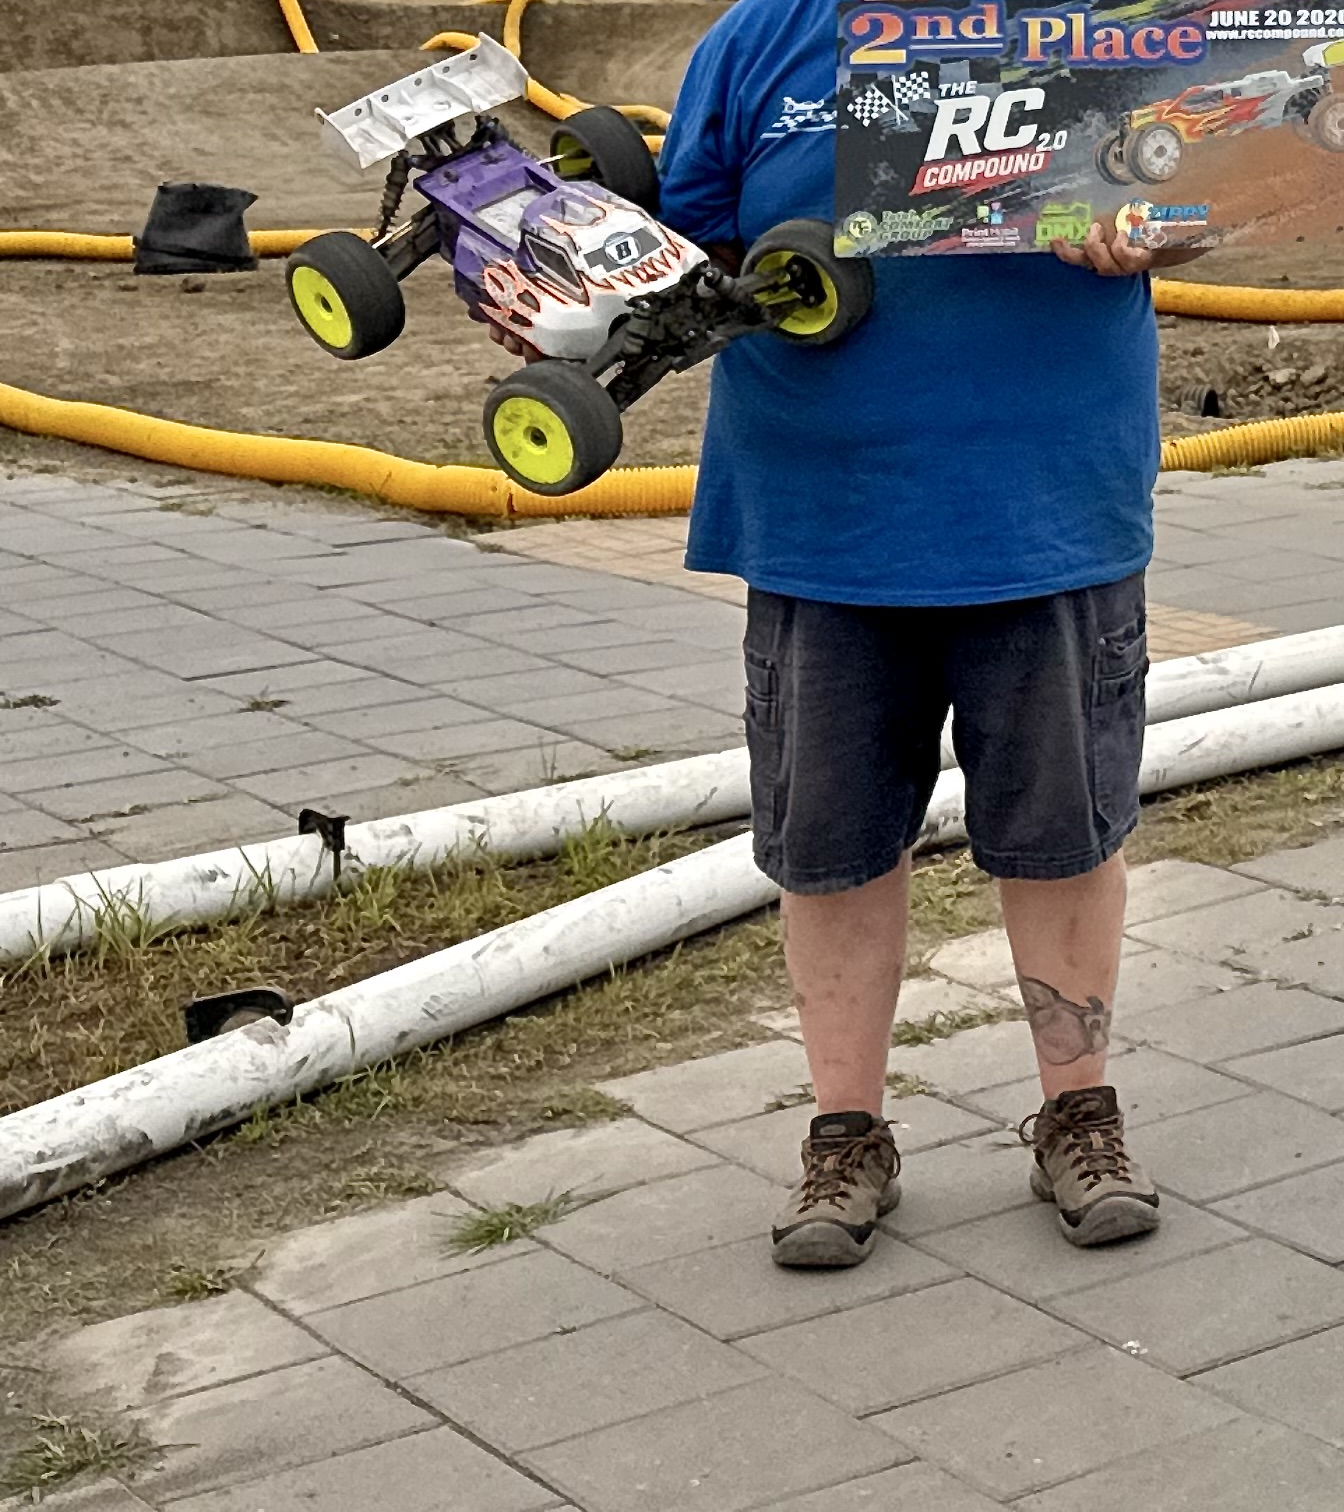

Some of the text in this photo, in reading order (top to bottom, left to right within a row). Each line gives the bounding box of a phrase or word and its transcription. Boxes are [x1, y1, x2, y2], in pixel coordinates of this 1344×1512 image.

[850, 3, 1202, 65] 2nd Place
[1209, 10, 1260, 29] JUNE
[1263, 9, 1293, 27] 20
[938, 80, 978, 97] THE
[924, 87, 1046, 162] RC
[923, 152, 1046, 188] COMPOUND
